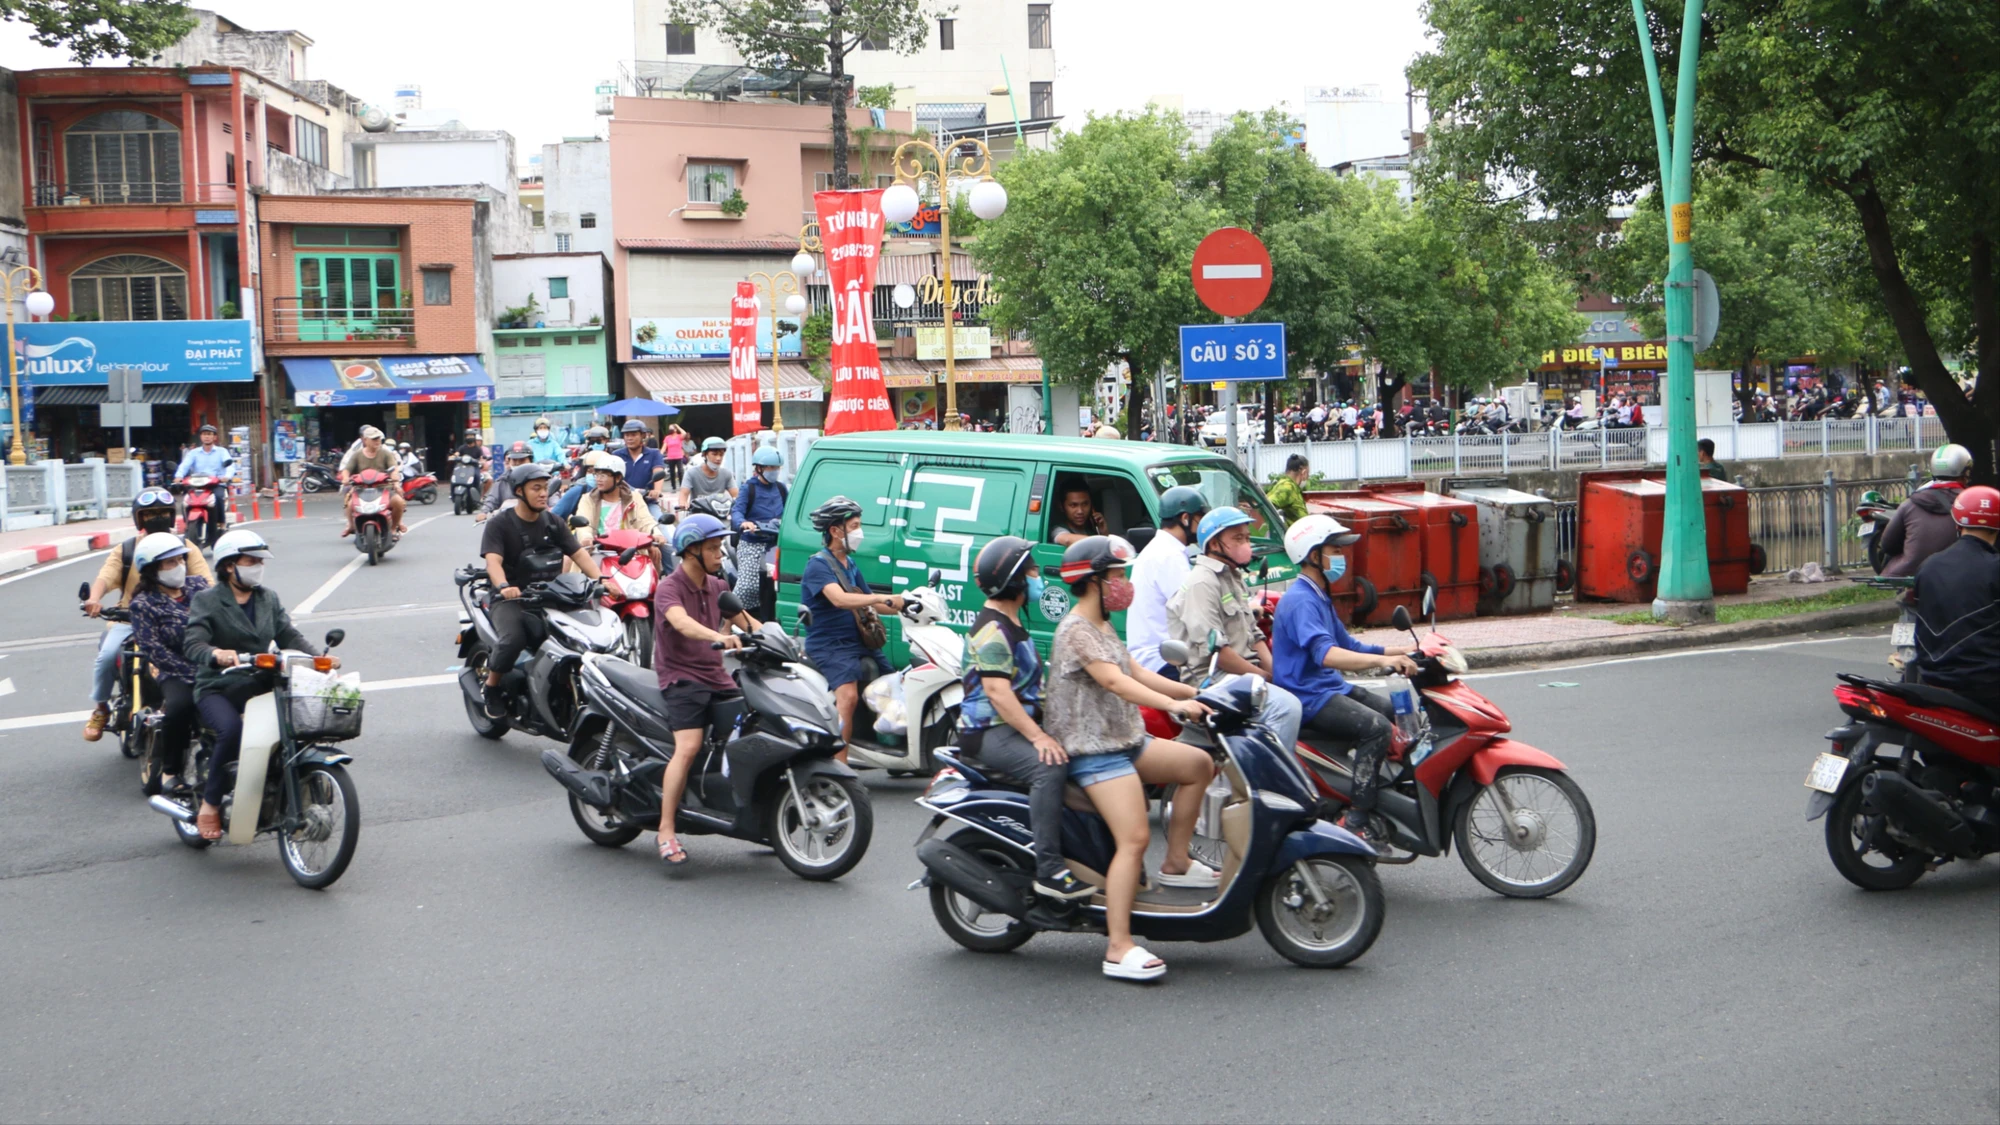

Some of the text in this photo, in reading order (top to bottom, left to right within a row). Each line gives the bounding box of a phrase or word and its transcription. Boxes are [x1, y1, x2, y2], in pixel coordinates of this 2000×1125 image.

[675, 329, 724, 339] QUANG
[185, 346, 243, 361] ĐẠI PHÁT
[1190, 339, 1276, 363] CẦU SỐ 3
[1562, 345, 1614, 365] ĐIỆN
[936, 583, 963, 601] AST
